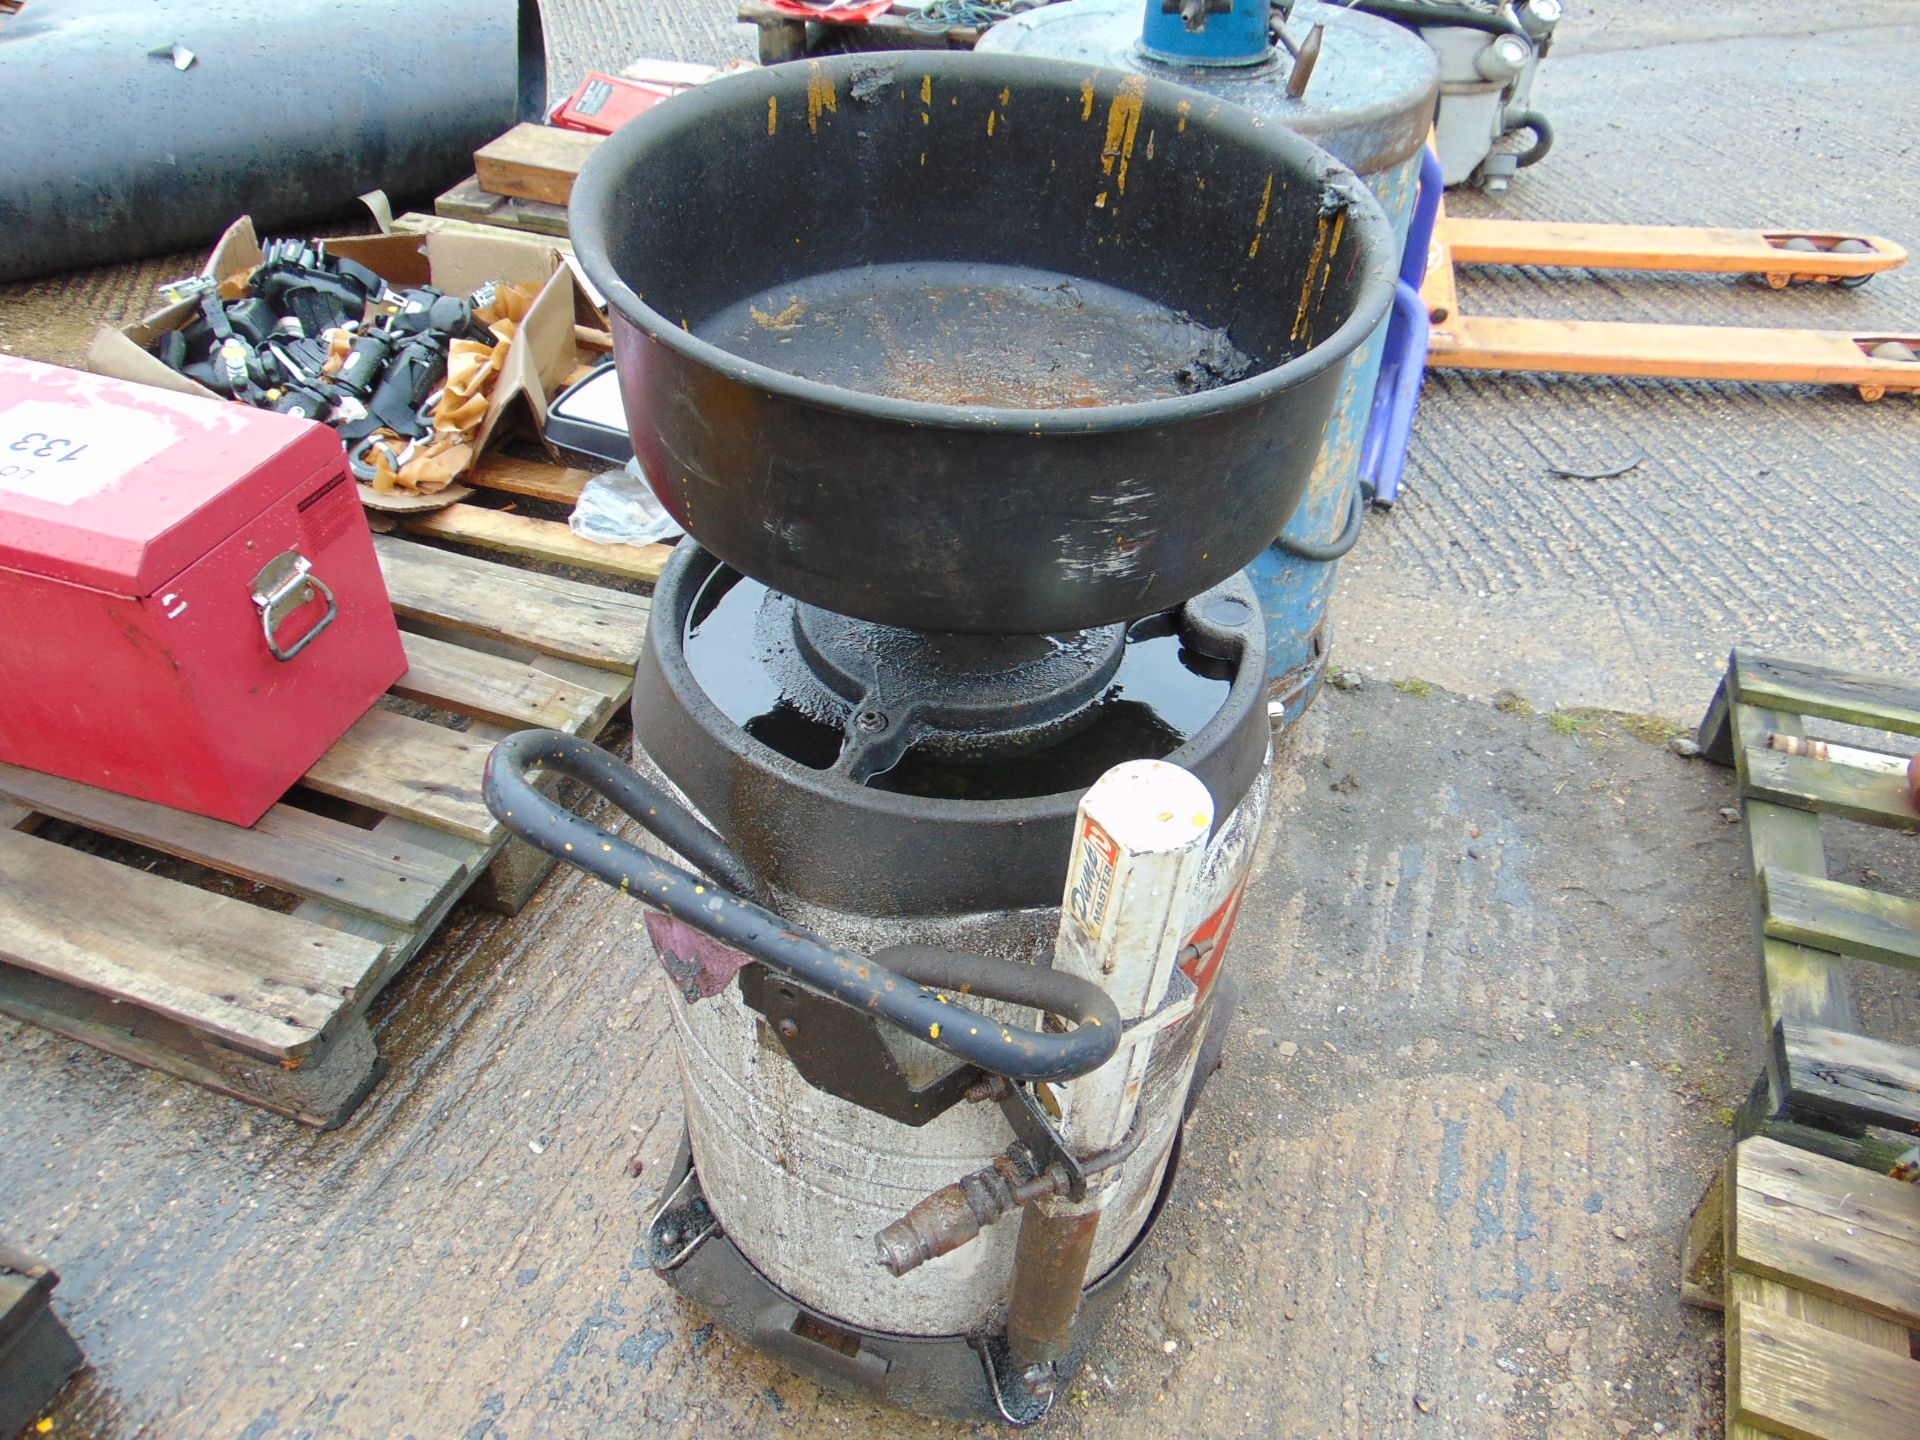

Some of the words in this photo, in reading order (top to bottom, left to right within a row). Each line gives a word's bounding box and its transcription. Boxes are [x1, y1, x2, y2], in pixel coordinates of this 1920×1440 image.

[9, 433, 88, 462] 133
[0, 465, 35, 480] LO
[1071, 842, 1101, 930] Dump
[1093, 864, 1113, 925] MASTER
